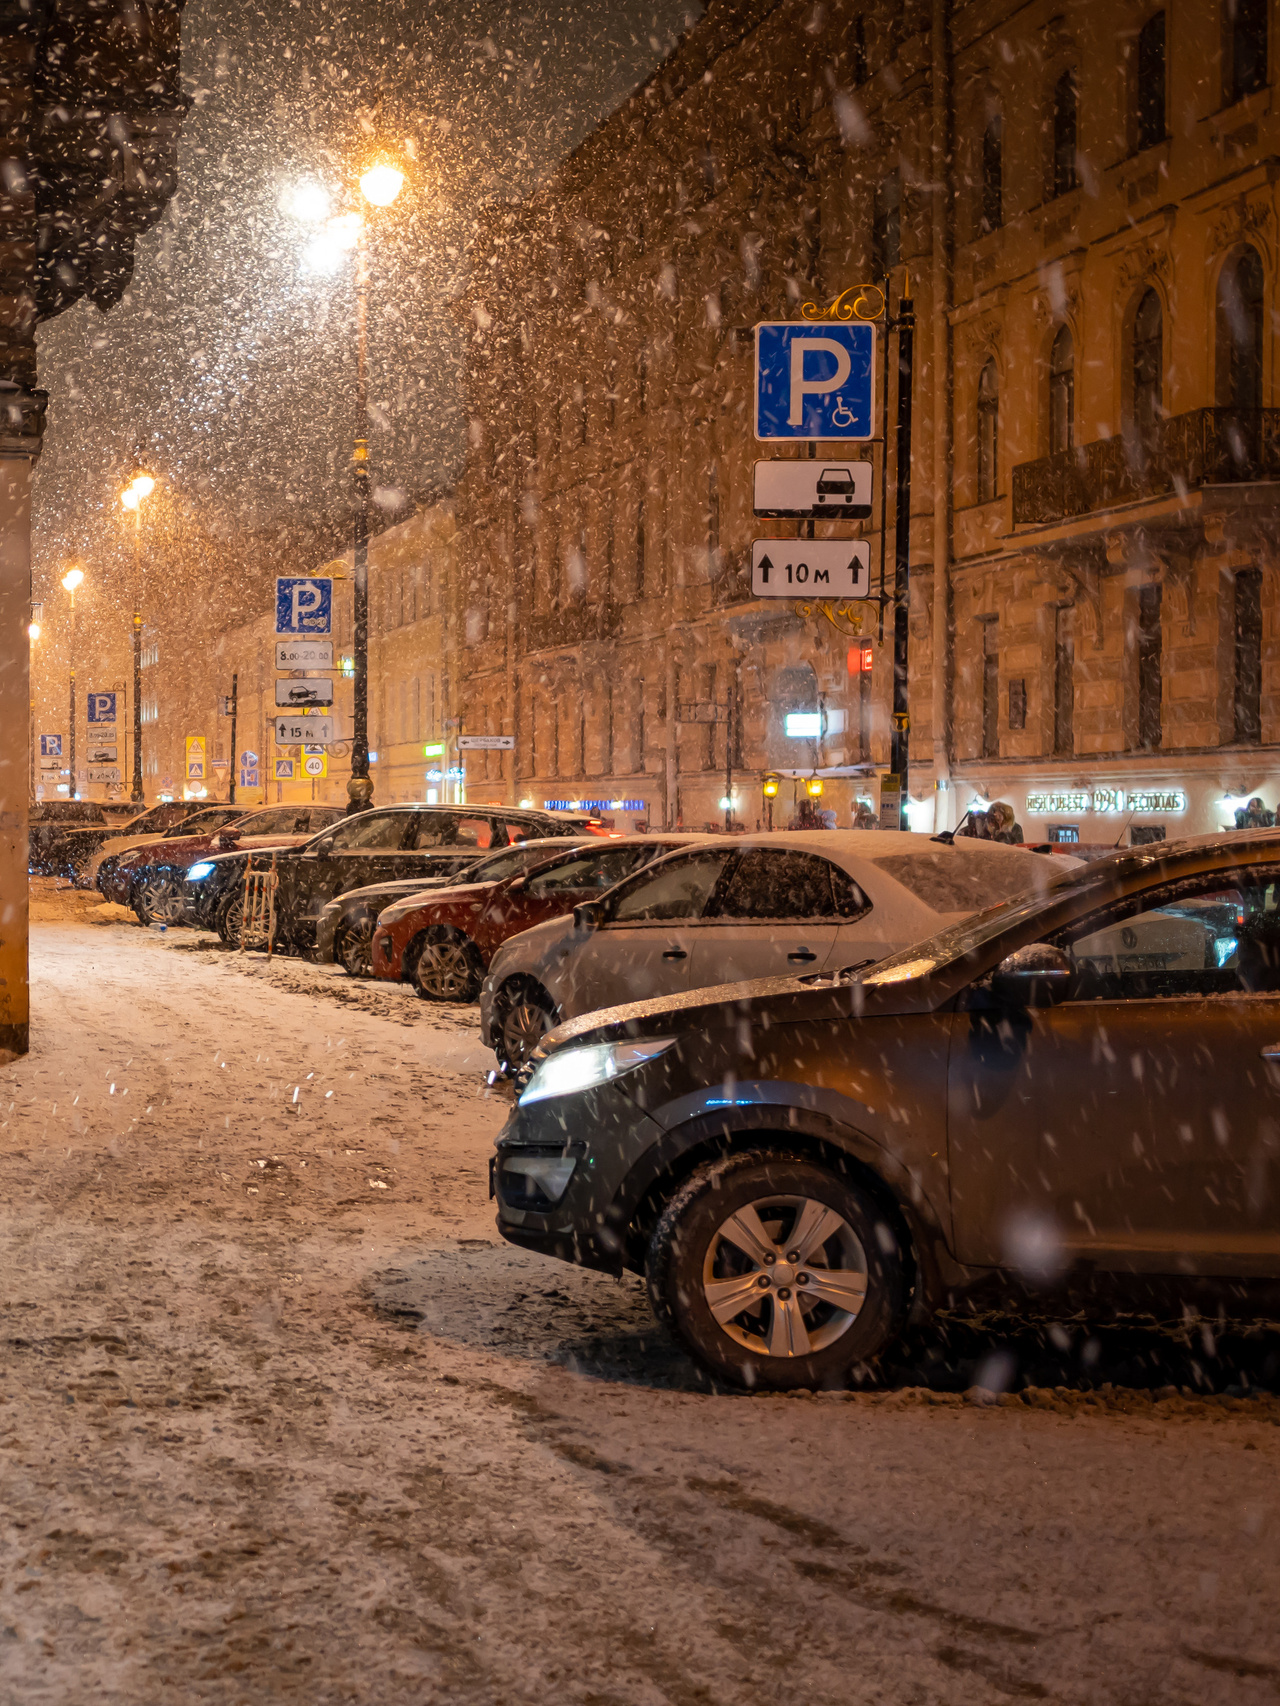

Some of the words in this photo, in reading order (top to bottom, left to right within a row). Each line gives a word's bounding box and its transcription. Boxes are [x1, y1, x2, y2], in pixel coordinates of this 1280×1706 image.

[789, 337, 851, 426] P
[292, 583, 322, 628] P
[290, 727, 302, 737] 15
[308, 762, 320, 770] 40
